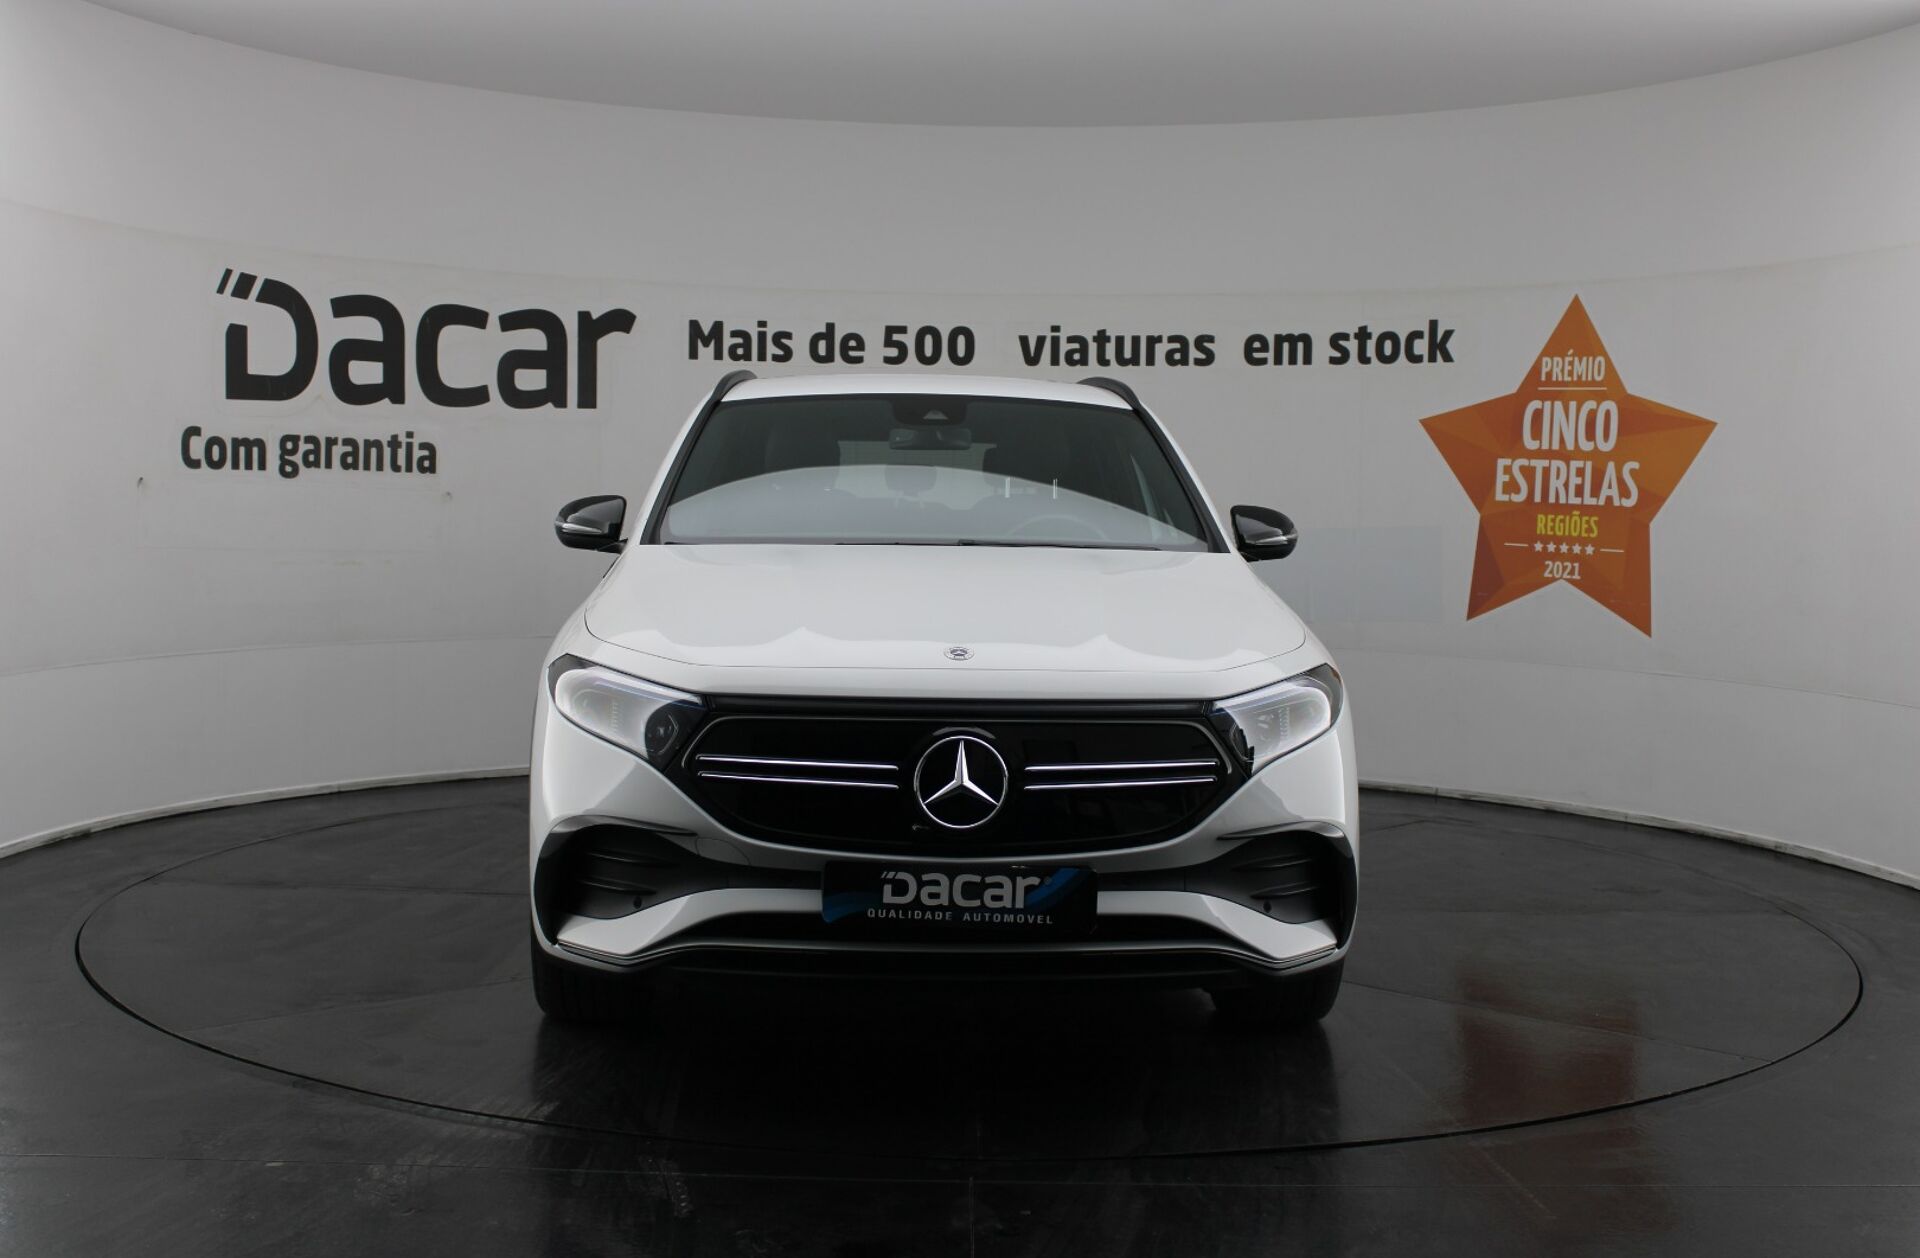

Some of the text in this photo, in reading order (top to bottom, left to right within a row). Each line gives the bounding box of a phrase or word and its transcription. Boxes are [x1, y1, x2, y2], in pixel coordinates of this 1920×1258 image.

[216, 268, 637, 410] Dacar
[687, 319, 1456, 367] Mais de 500 viaturas em stock
[1541, 349, 1606, 382] PRÉMIO
[1522, 400, 1619, 452] CINCO
[180, 425, 438, 479] Com garantia
[1495, 458, 1640, 508] ESTRELAS
[1536, 511, 1599, 538] REGIÕES
[1543, 560, 1581, 580] 2021
[880, 871, 1041, 909] Dacar
[866, 908, 953, 921] QUALIDADE
